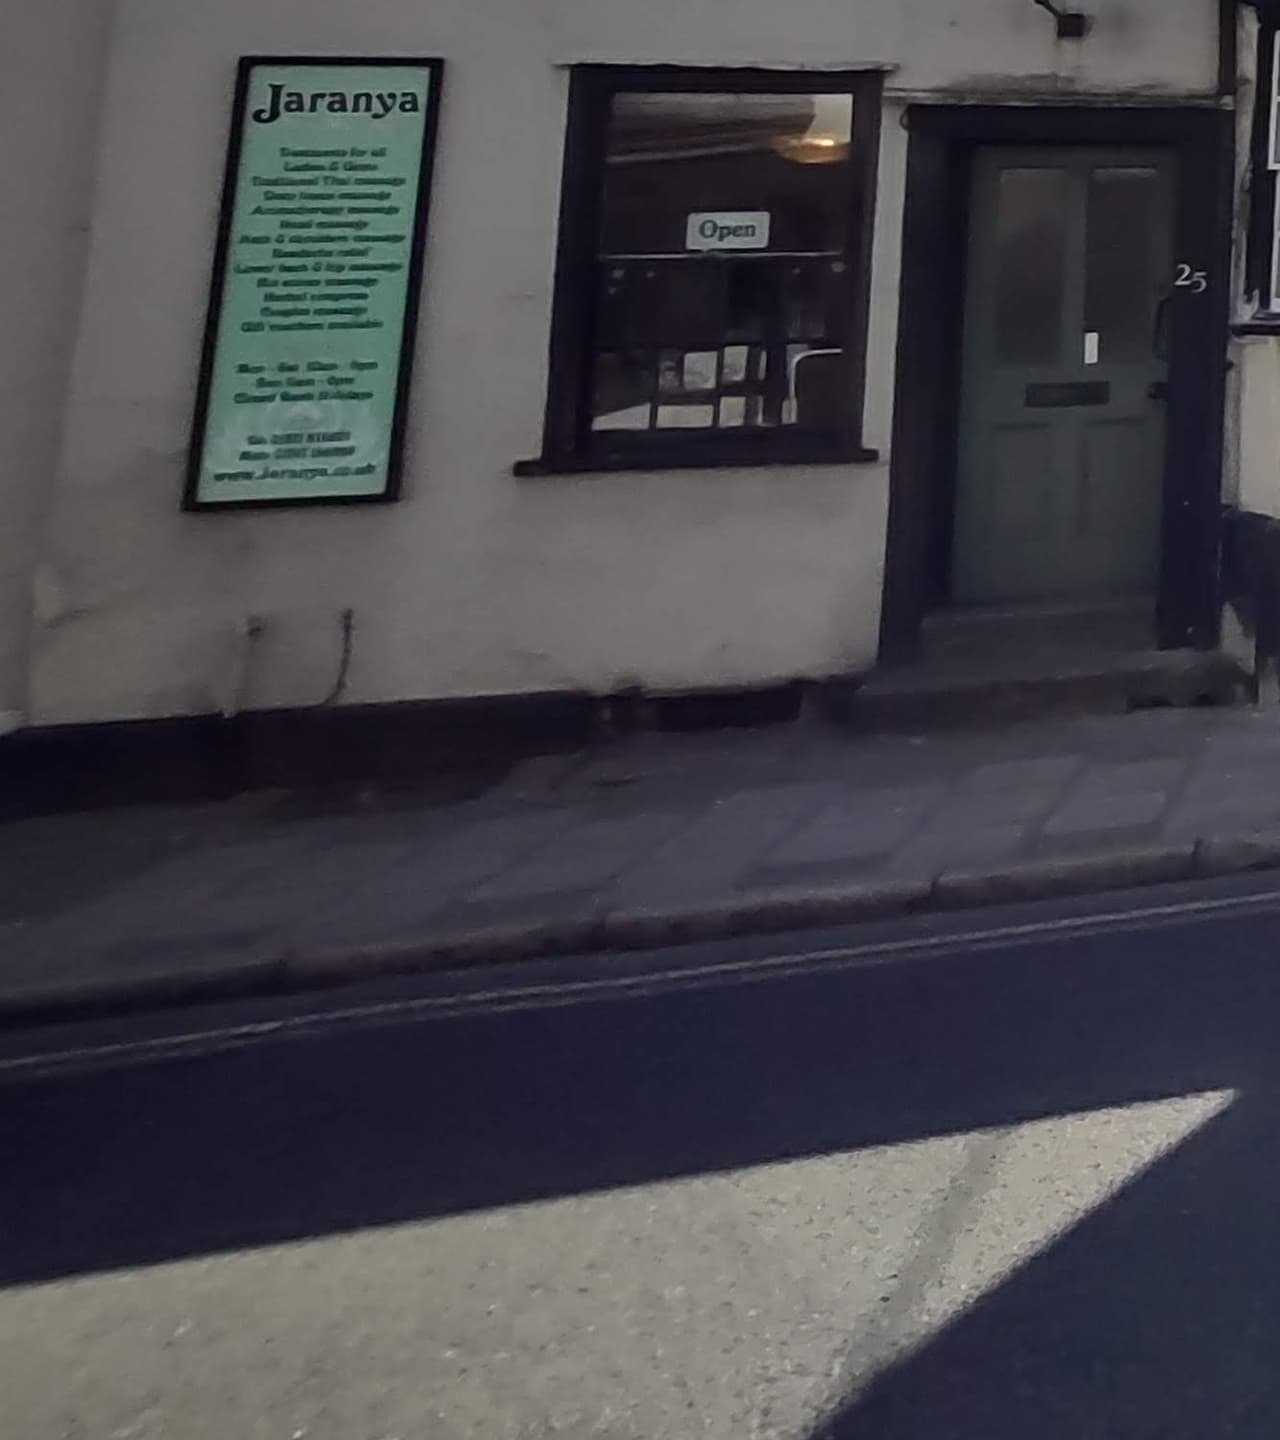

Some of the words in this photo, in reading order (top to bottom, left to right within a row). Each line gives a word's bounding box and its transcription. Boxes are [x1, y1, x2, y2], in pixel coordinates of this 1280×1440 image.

[252, 83, 419, 123] Jaranya
[699, 219, 756, 242] Open
[1174, 264, 1207, 293] 25
